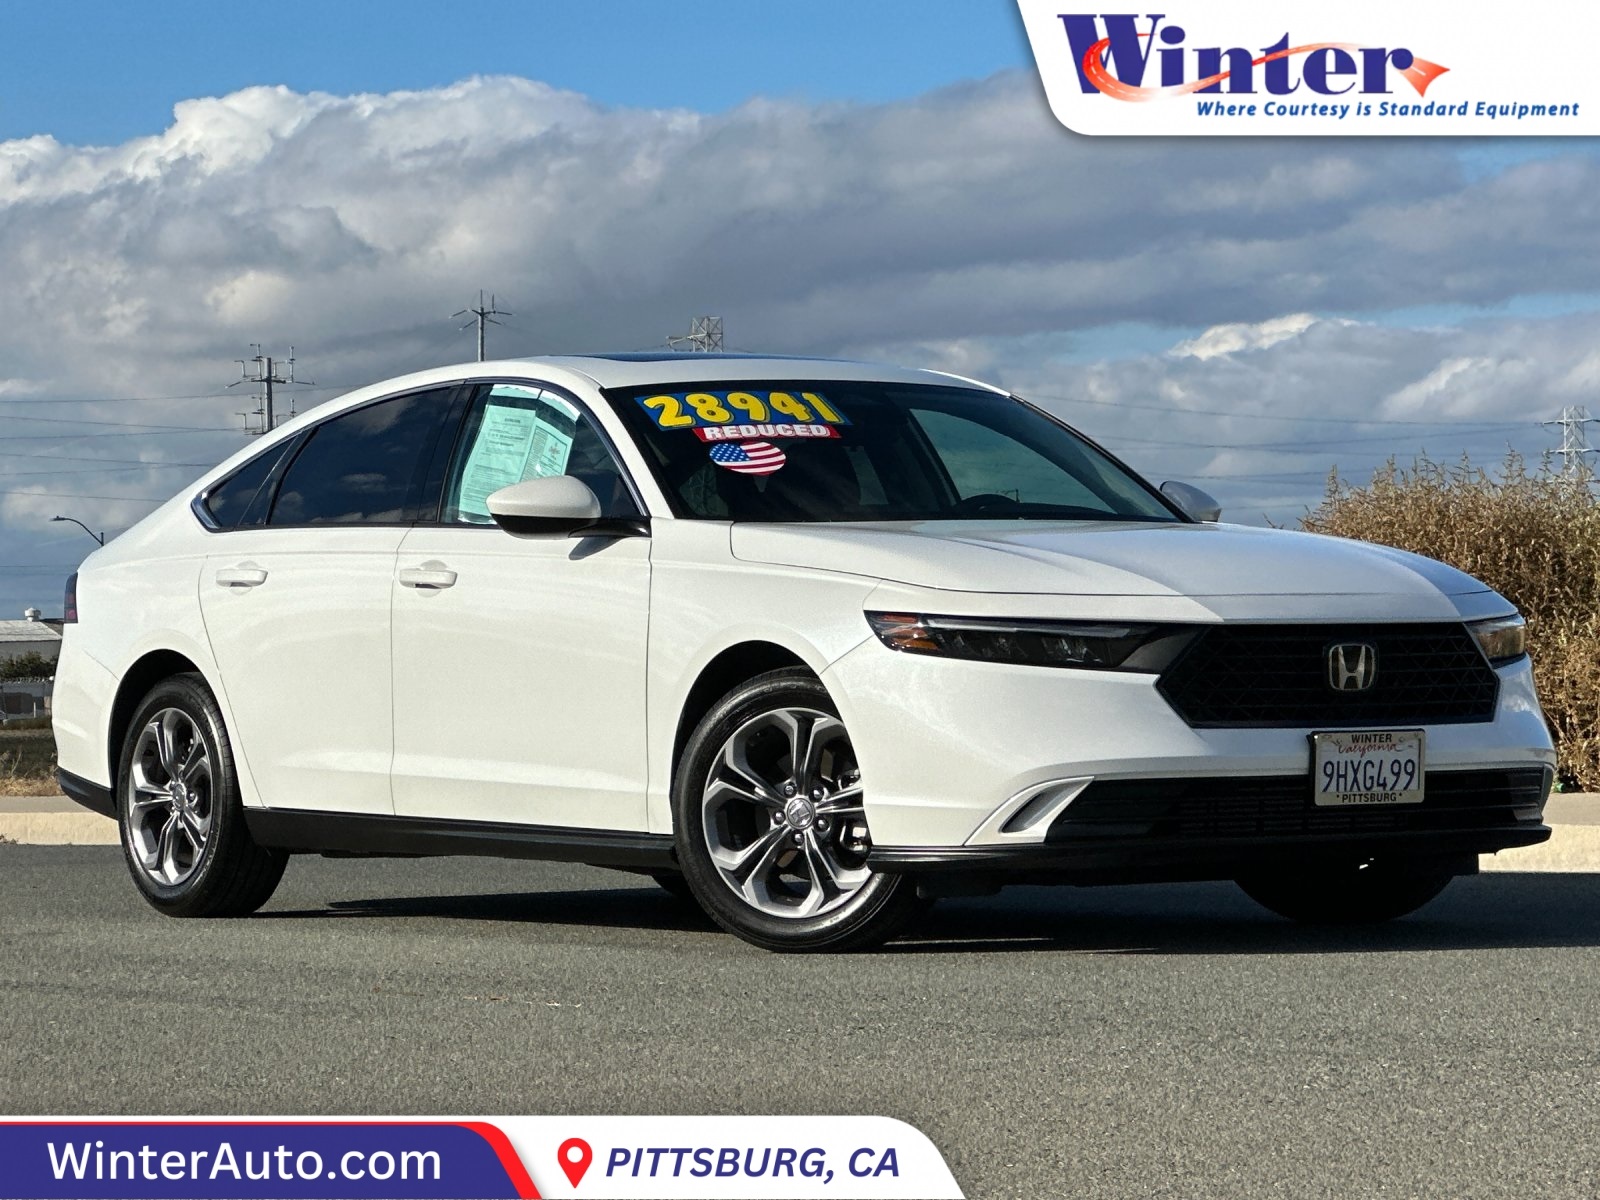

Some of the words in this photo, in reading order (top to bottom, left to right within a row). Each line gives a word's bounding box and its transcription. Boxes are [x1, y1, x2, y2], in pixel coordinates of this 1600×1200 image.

[643, 391, 843, 427] 28941
[702, 424, 830, 441] REDUCED
[1351, 733, 1393, 744] WINTER
[1321, 758, 1416, 793] 9HXG499
[1341, 792, 1397, 804] PITTSBURG
